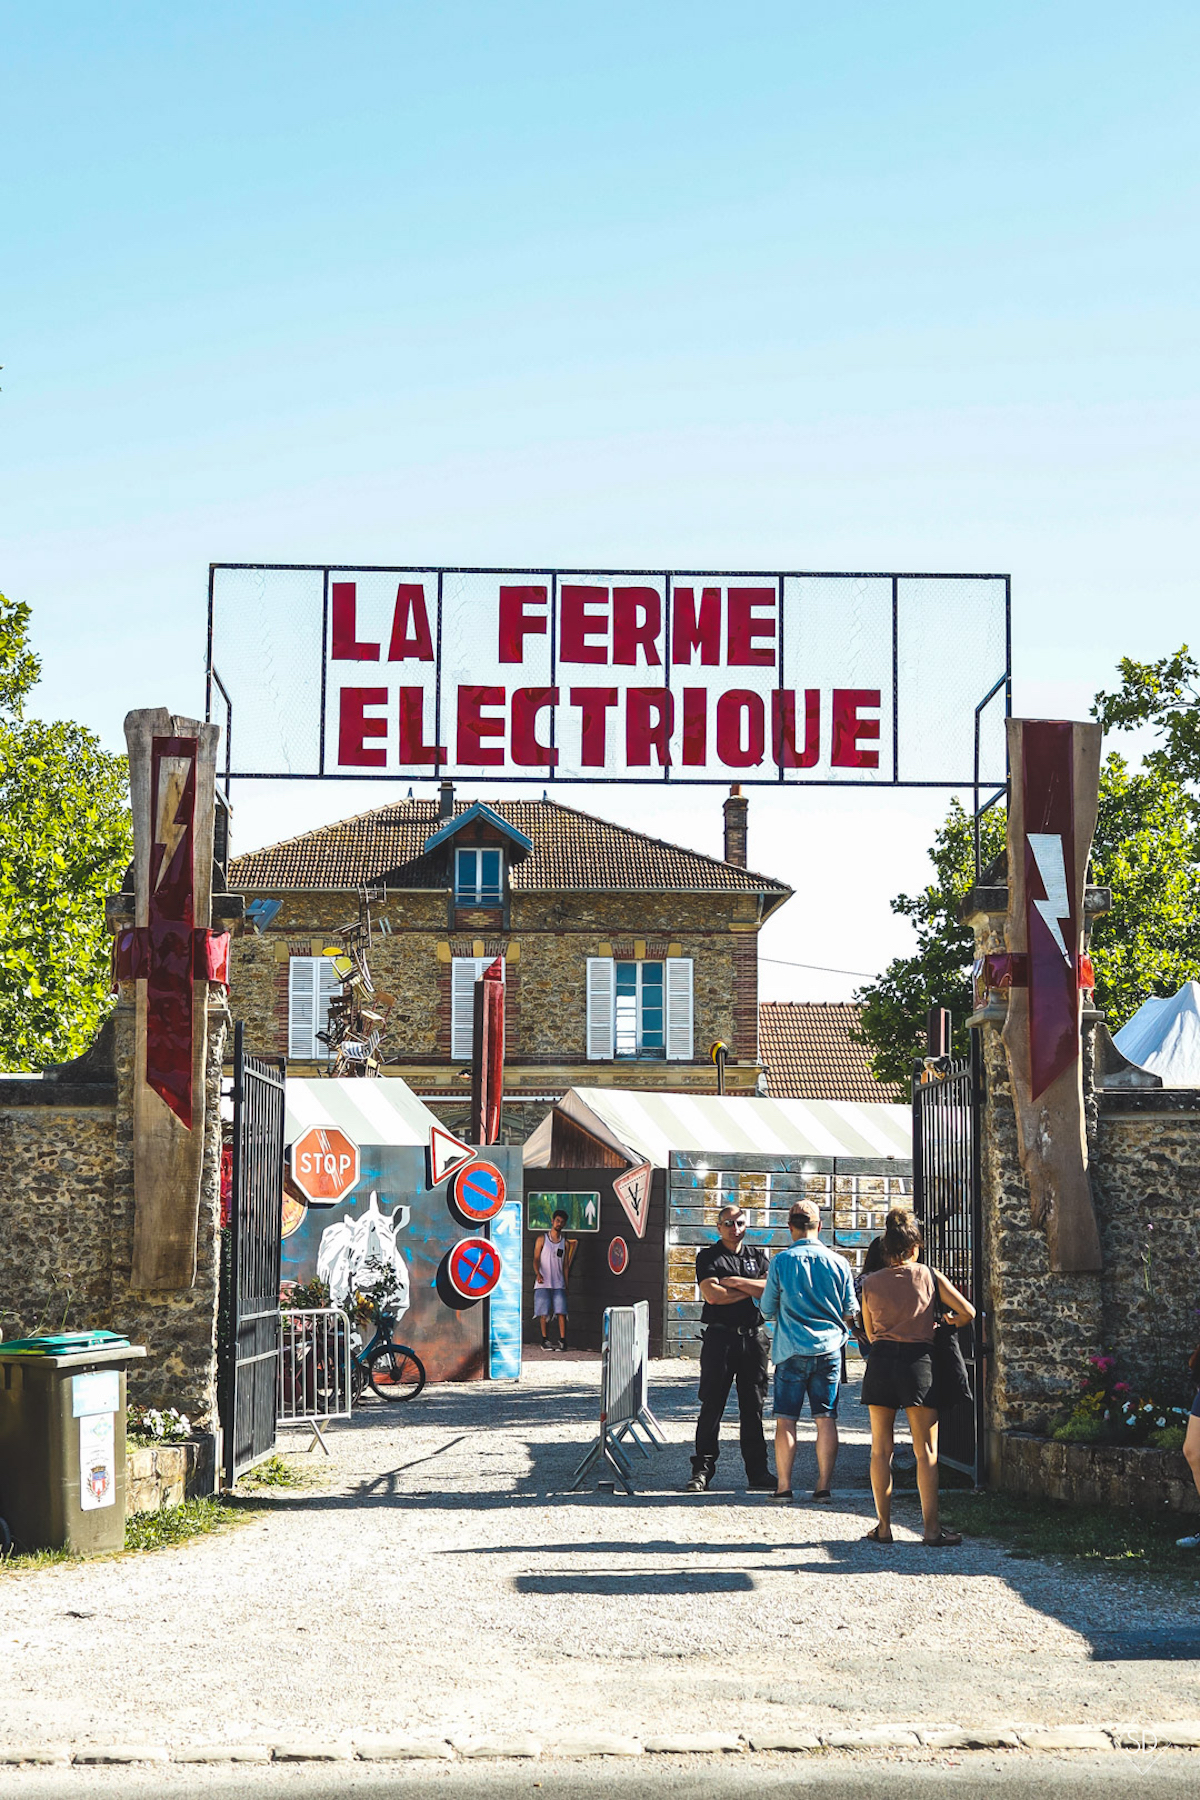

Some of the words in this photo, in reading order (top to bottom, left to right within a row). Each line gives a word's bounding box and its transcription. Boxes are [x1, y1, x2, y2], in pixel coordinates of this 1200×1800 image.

[332, 582, 434, 662] LA
[498, 585, 776, 667] FERME
[337, 685, 881, 769] ELECTRIQUE
[300, 1152, 351, 1175] STOP
